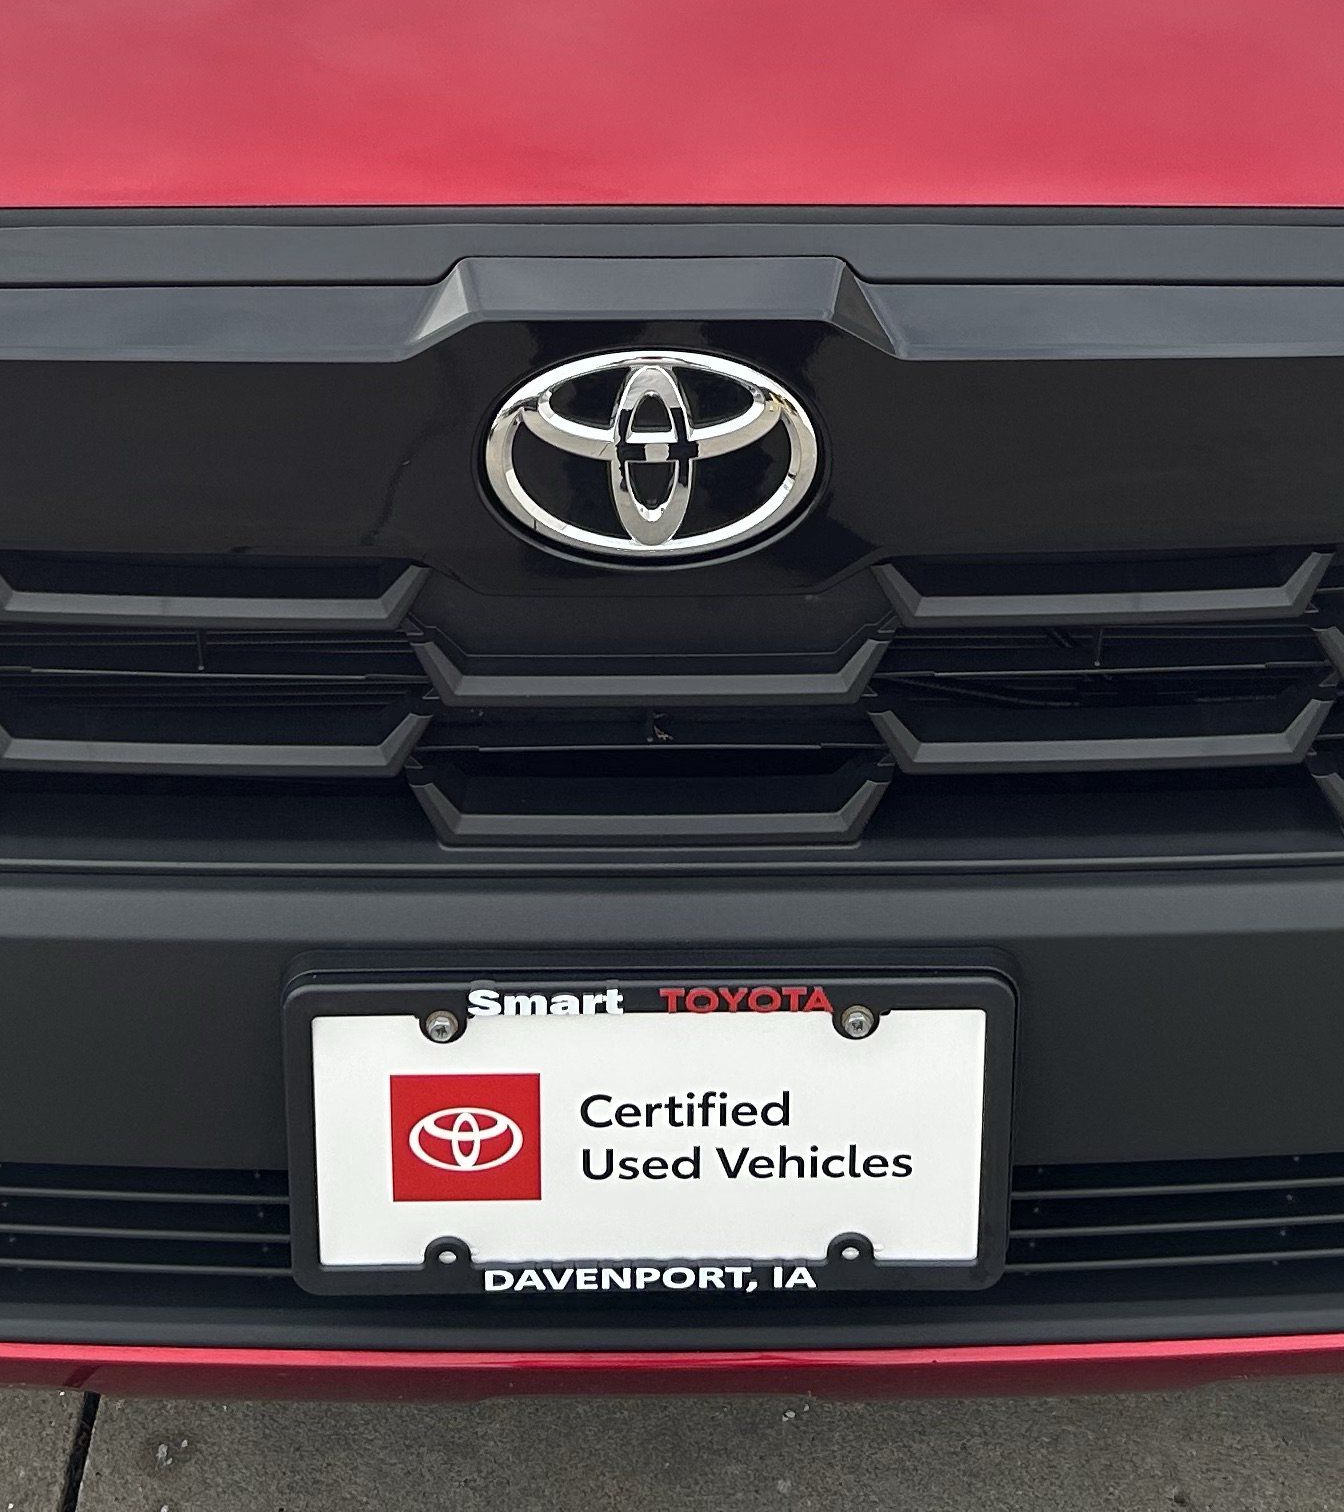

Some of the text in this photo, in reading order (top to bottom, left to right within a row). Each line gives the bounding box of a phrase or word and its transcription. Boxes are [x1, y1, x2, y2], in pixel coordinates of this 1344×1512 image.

[467, 987, 834, 1018] Smart TOYOTA
[579, 1090, 791, 1129] Certified
[581, 1144, 913, 1181] Used Vehicles
[484, 1266, 816, 1293] DAVENPORT, IA
